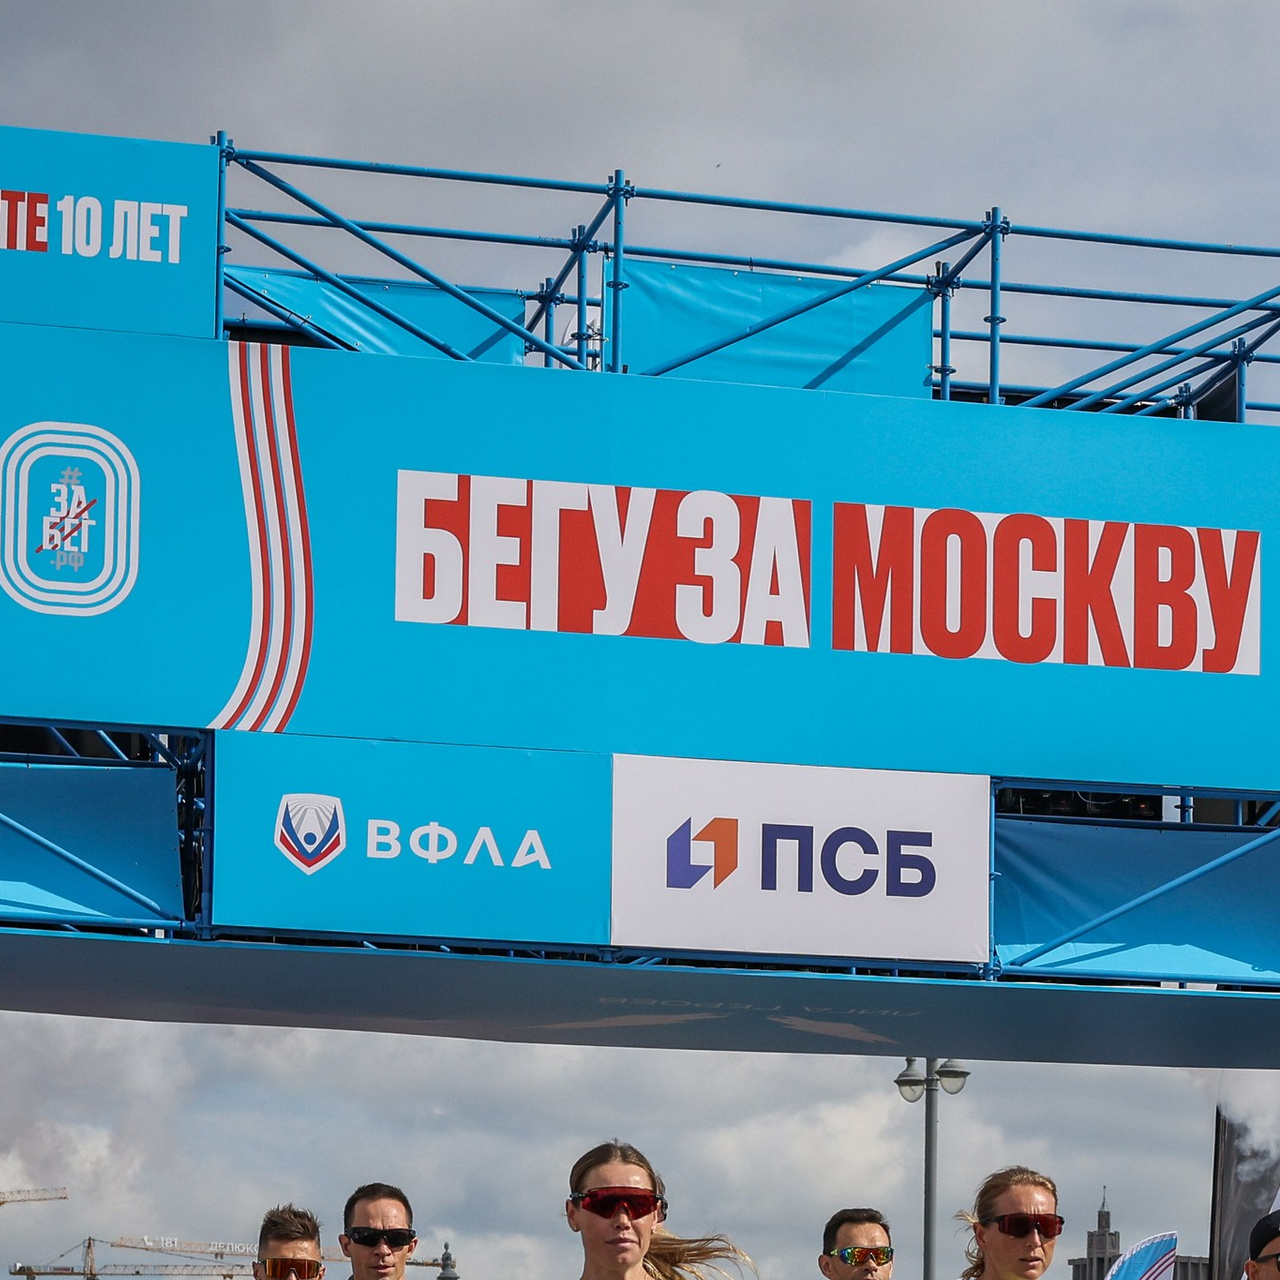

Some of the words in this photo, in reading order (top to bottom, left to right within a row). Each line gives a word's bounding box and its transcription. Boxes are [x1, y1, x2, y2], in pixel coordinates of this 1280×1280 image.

[56, 195, 103, 258] 10
[109, 199, 188, 264] ЛЕТ
[394, 469, 656, 637] БЕГУ
[674, 490, 811, 649] ЗА
[832, 503, 1260, 675] МОСКВУ
[366, 818, 553, 870] ВФЛА
[760, 823, 937, 898] ПСБ
